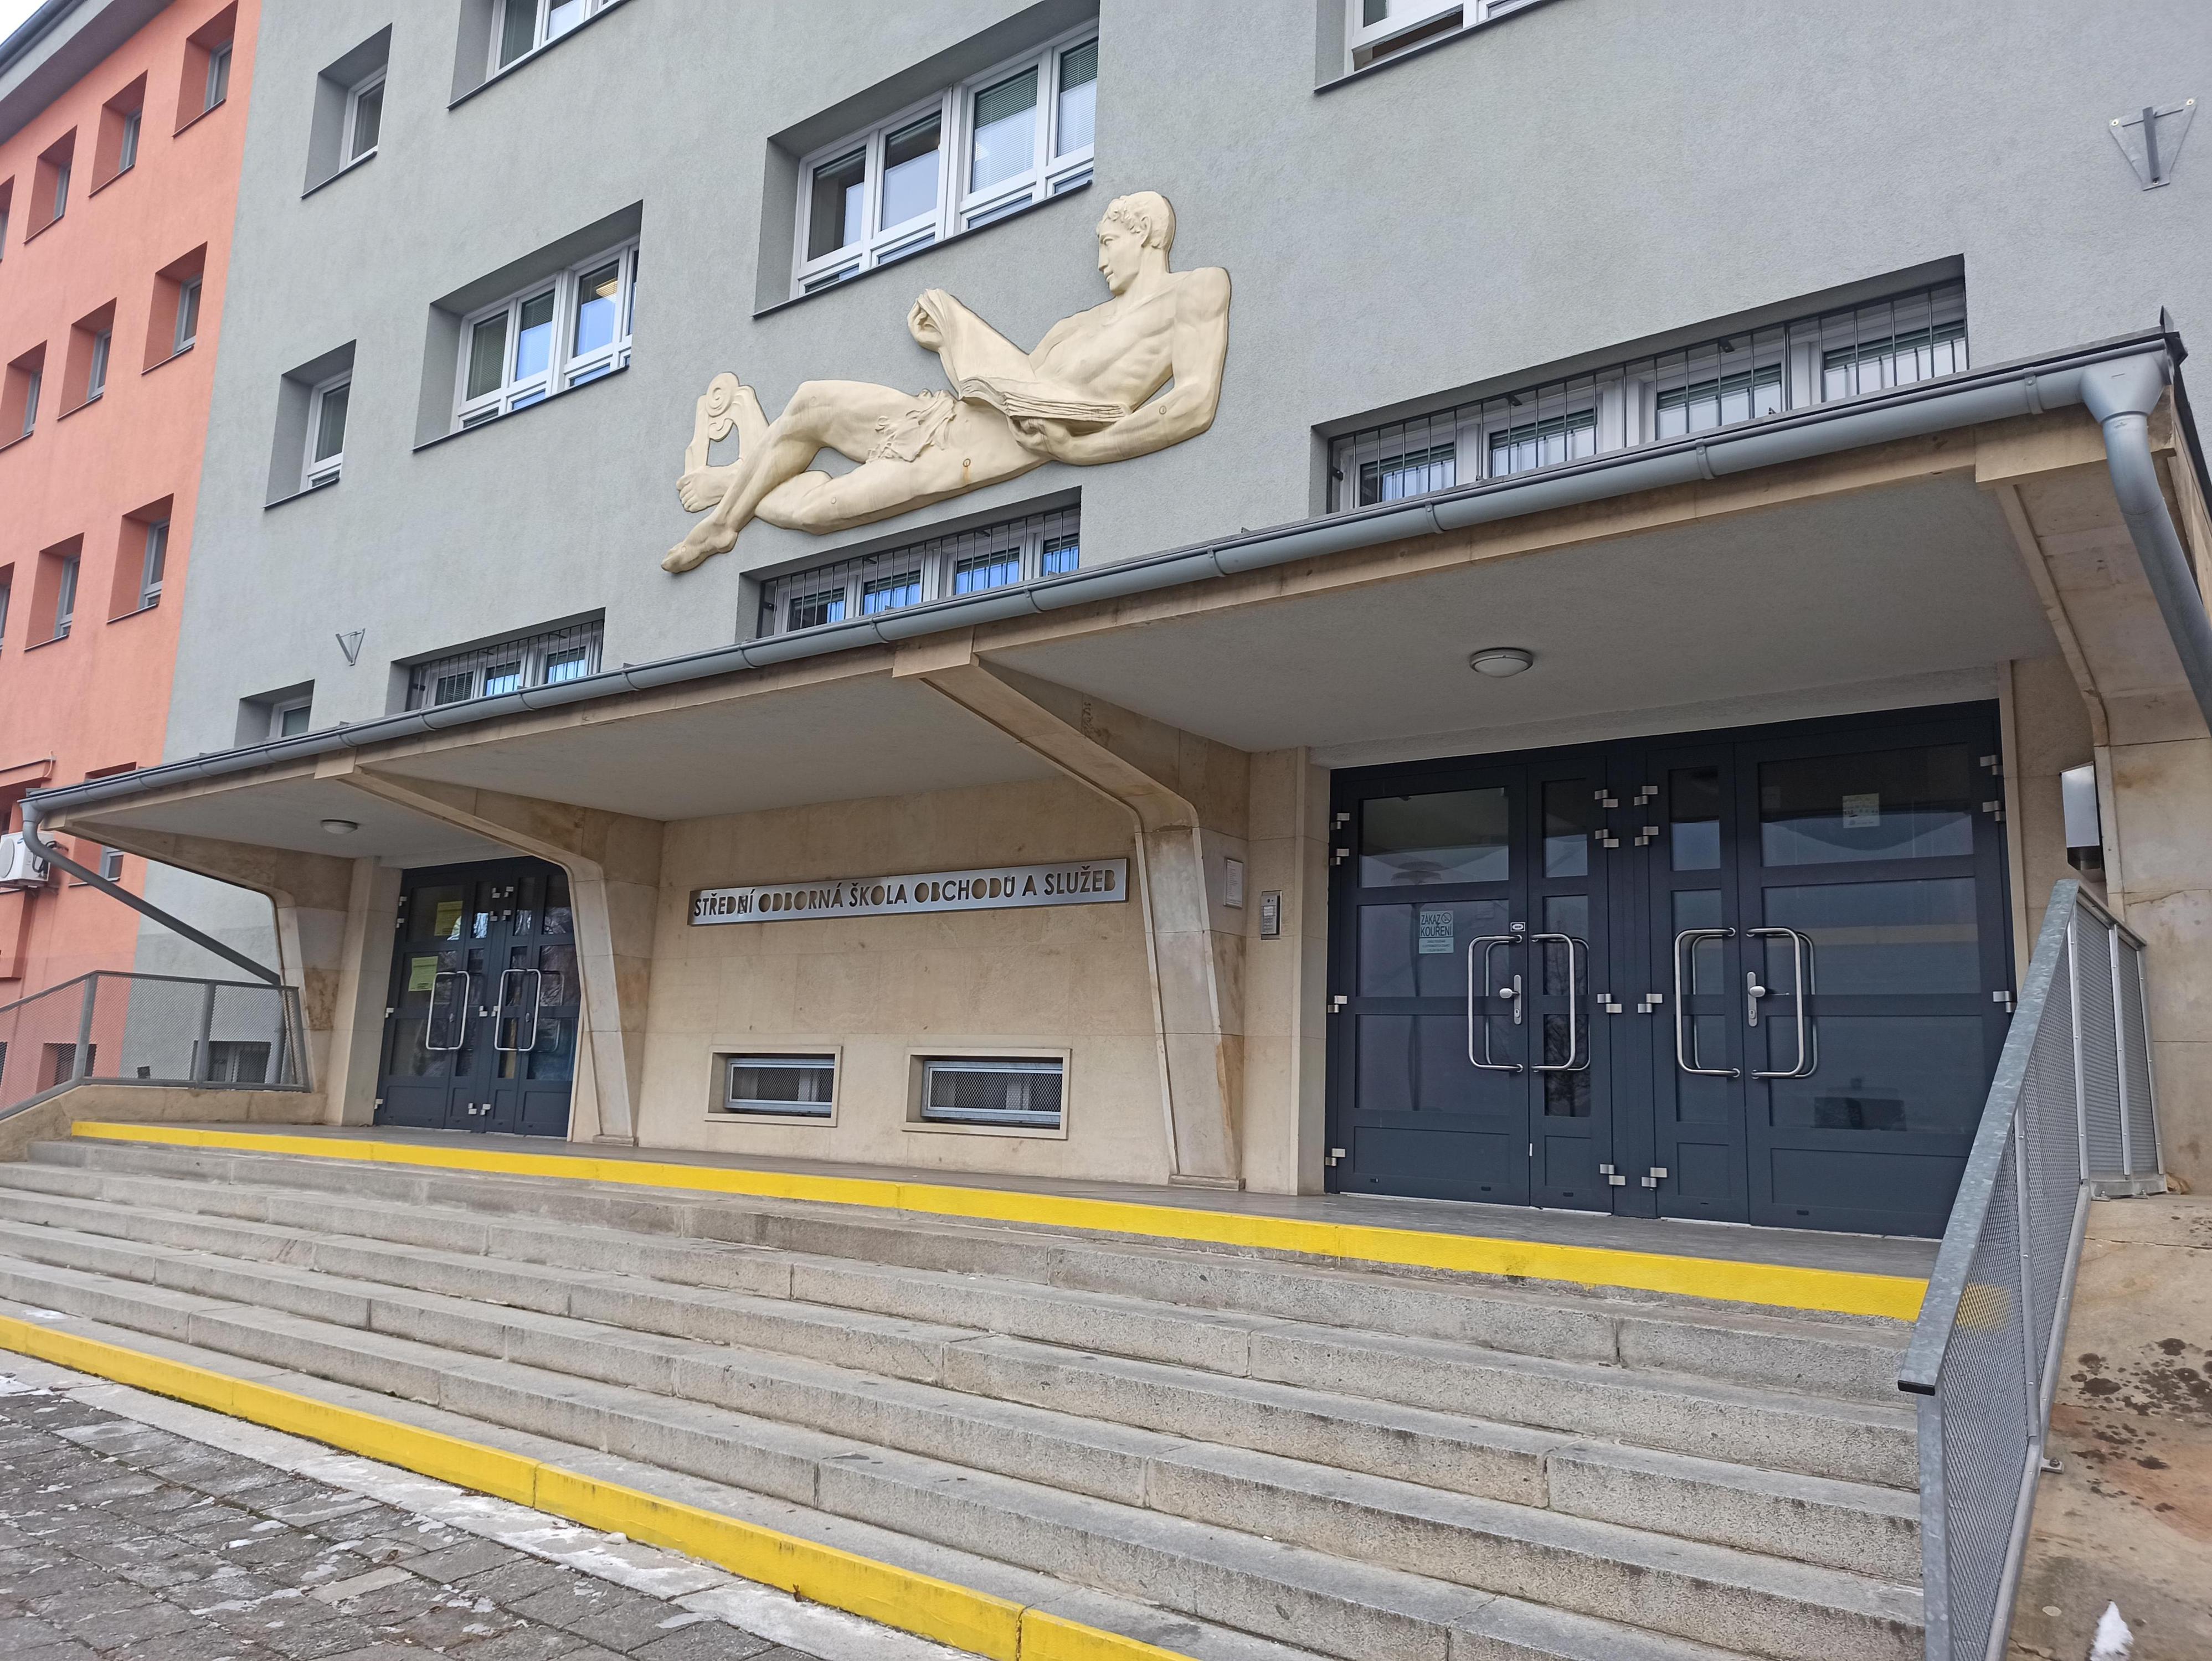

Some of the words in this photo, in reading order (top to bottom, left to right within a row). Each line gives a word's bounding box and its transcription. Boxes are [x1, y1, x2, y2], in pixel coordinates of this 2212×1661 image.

[694, 889, 756, 917] STŘEDNÍ
[758, 883, 843, 912] ODBORNÁ
[848, 883, 908, 907] ŠKOLA
[1022, 875, 1037, 896] A
[1044, 865, 1116, 895] SLUŽEB
[1421, 912, 1441, 925] ZÁKAZ
[1421, 923, 1452, 936] KOUŘENÍ
